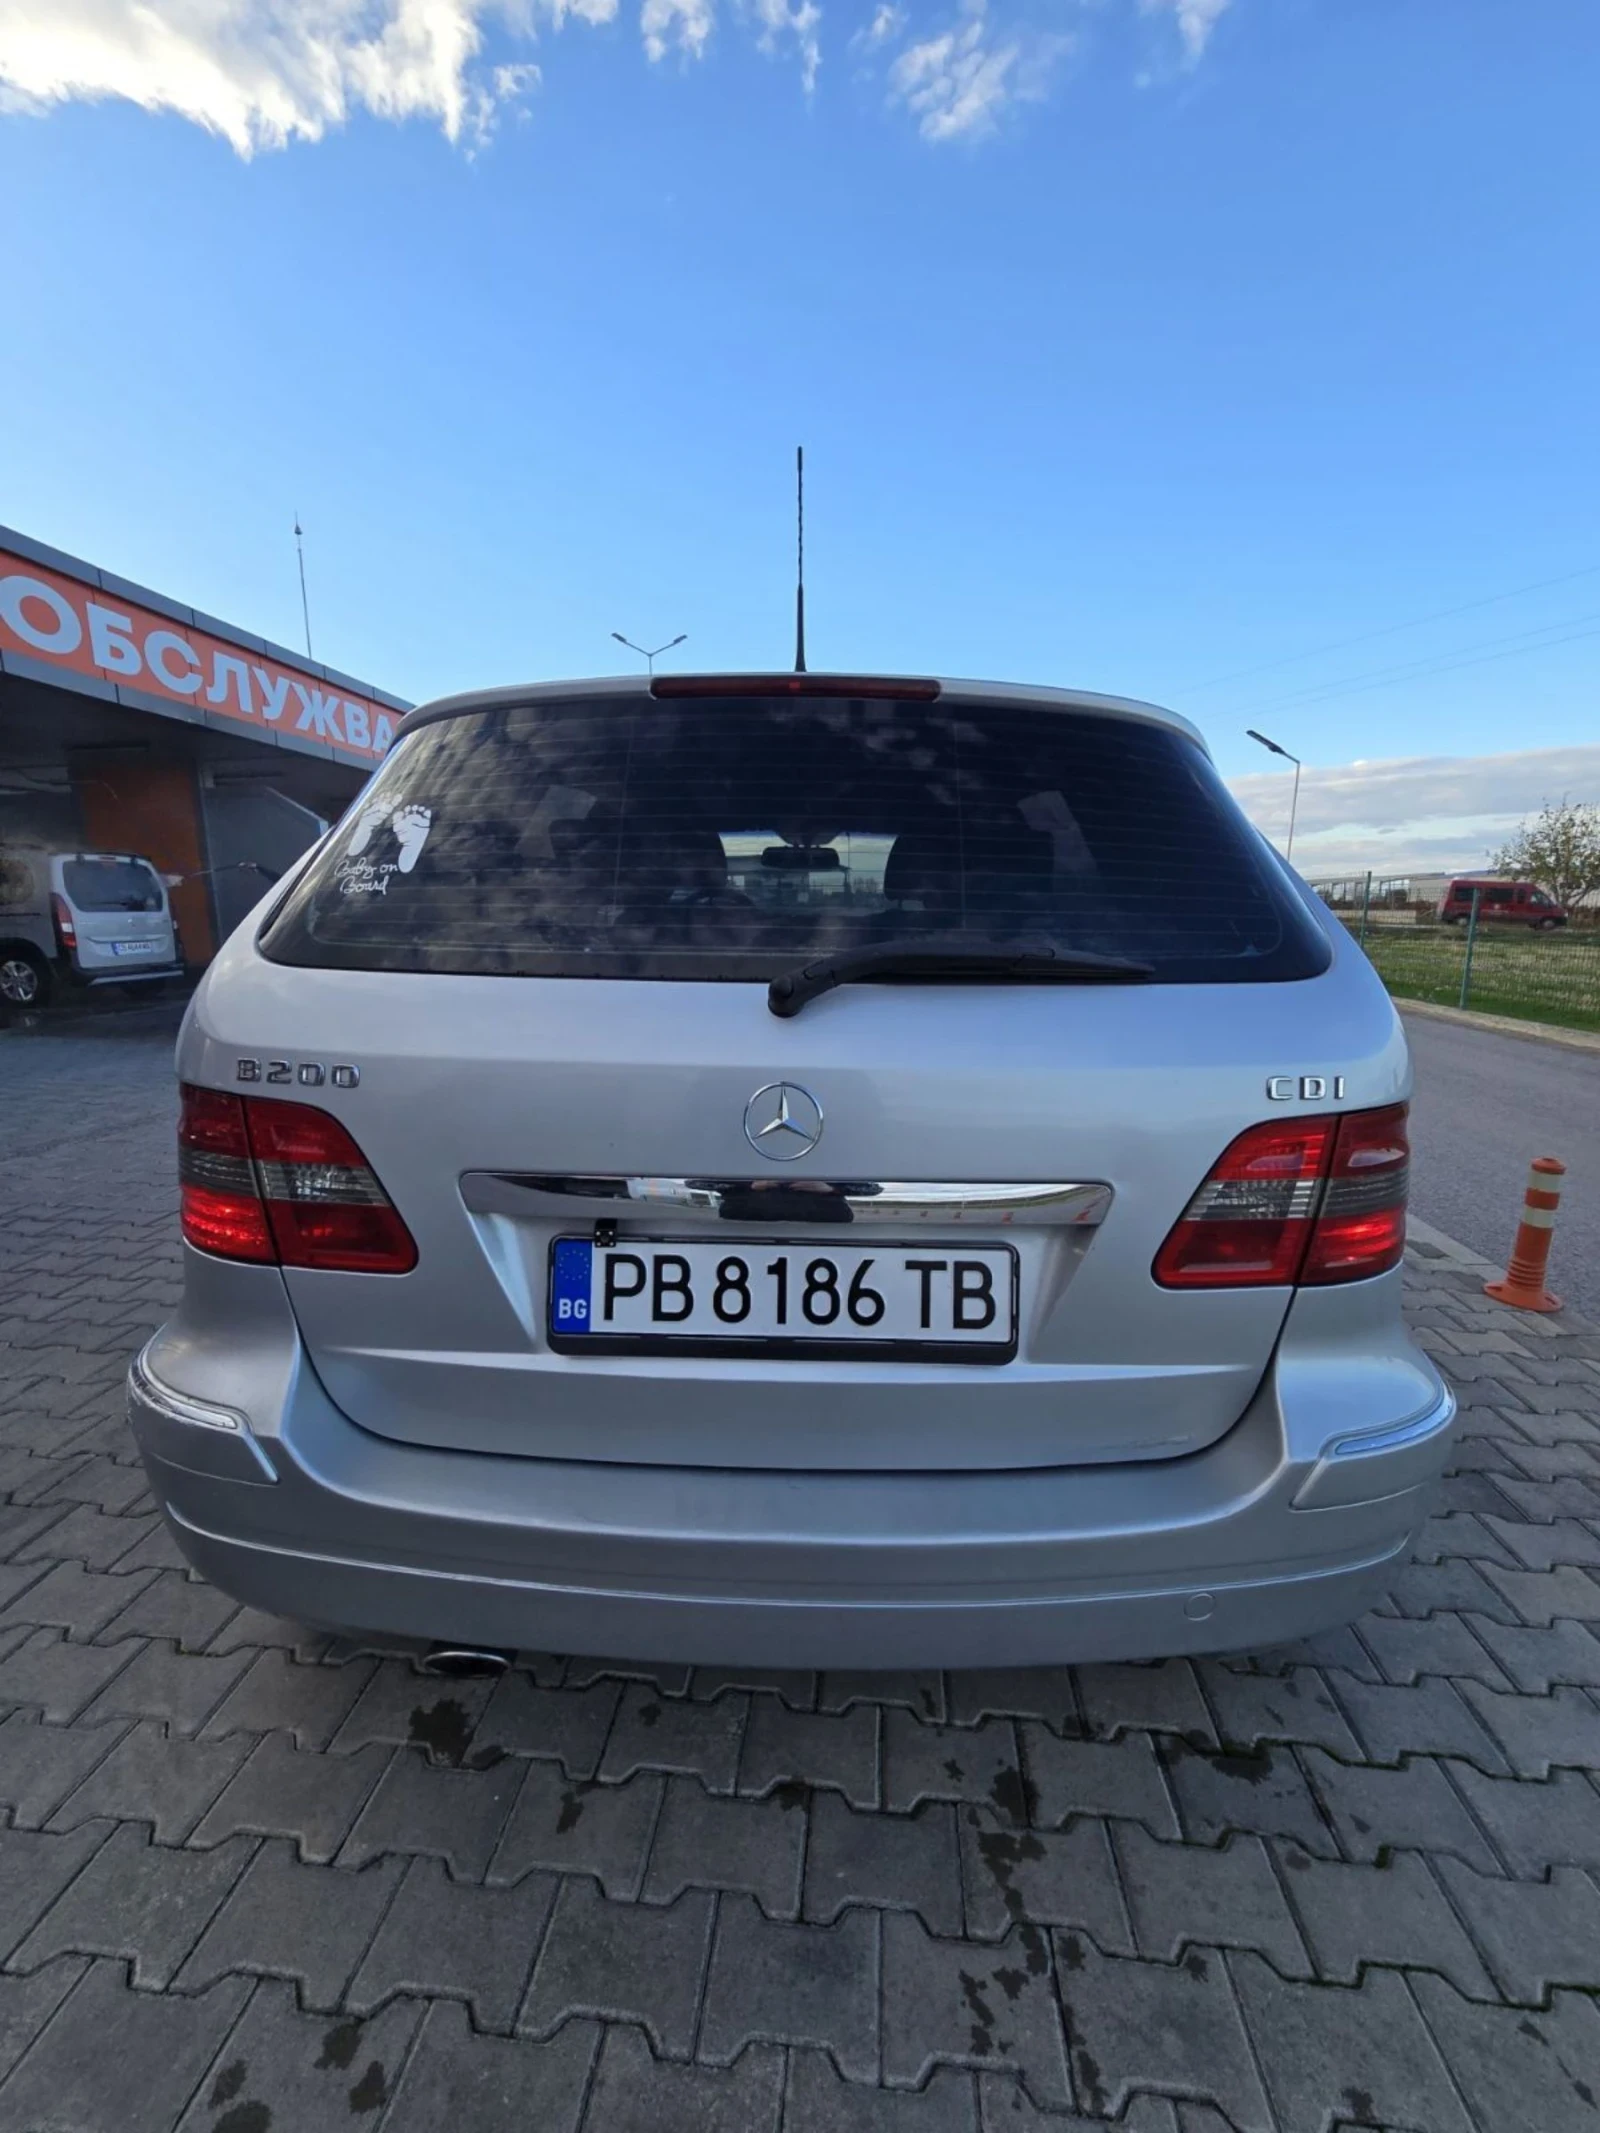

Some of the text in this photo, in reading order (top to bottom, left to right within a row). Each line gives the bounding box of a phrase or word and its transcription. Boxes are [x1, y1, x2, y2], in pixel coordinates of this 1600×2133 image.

[334, 857, 398, 879] Baby on
[340, 875, 389, 895] Board
[236, 1057, 360, 1088] B200
[1266, 1075, 1345, 1101] CDI
[603, 1253, 996, 1330] PB 8186 TB
[558, 1298, 588, 1319] BG
